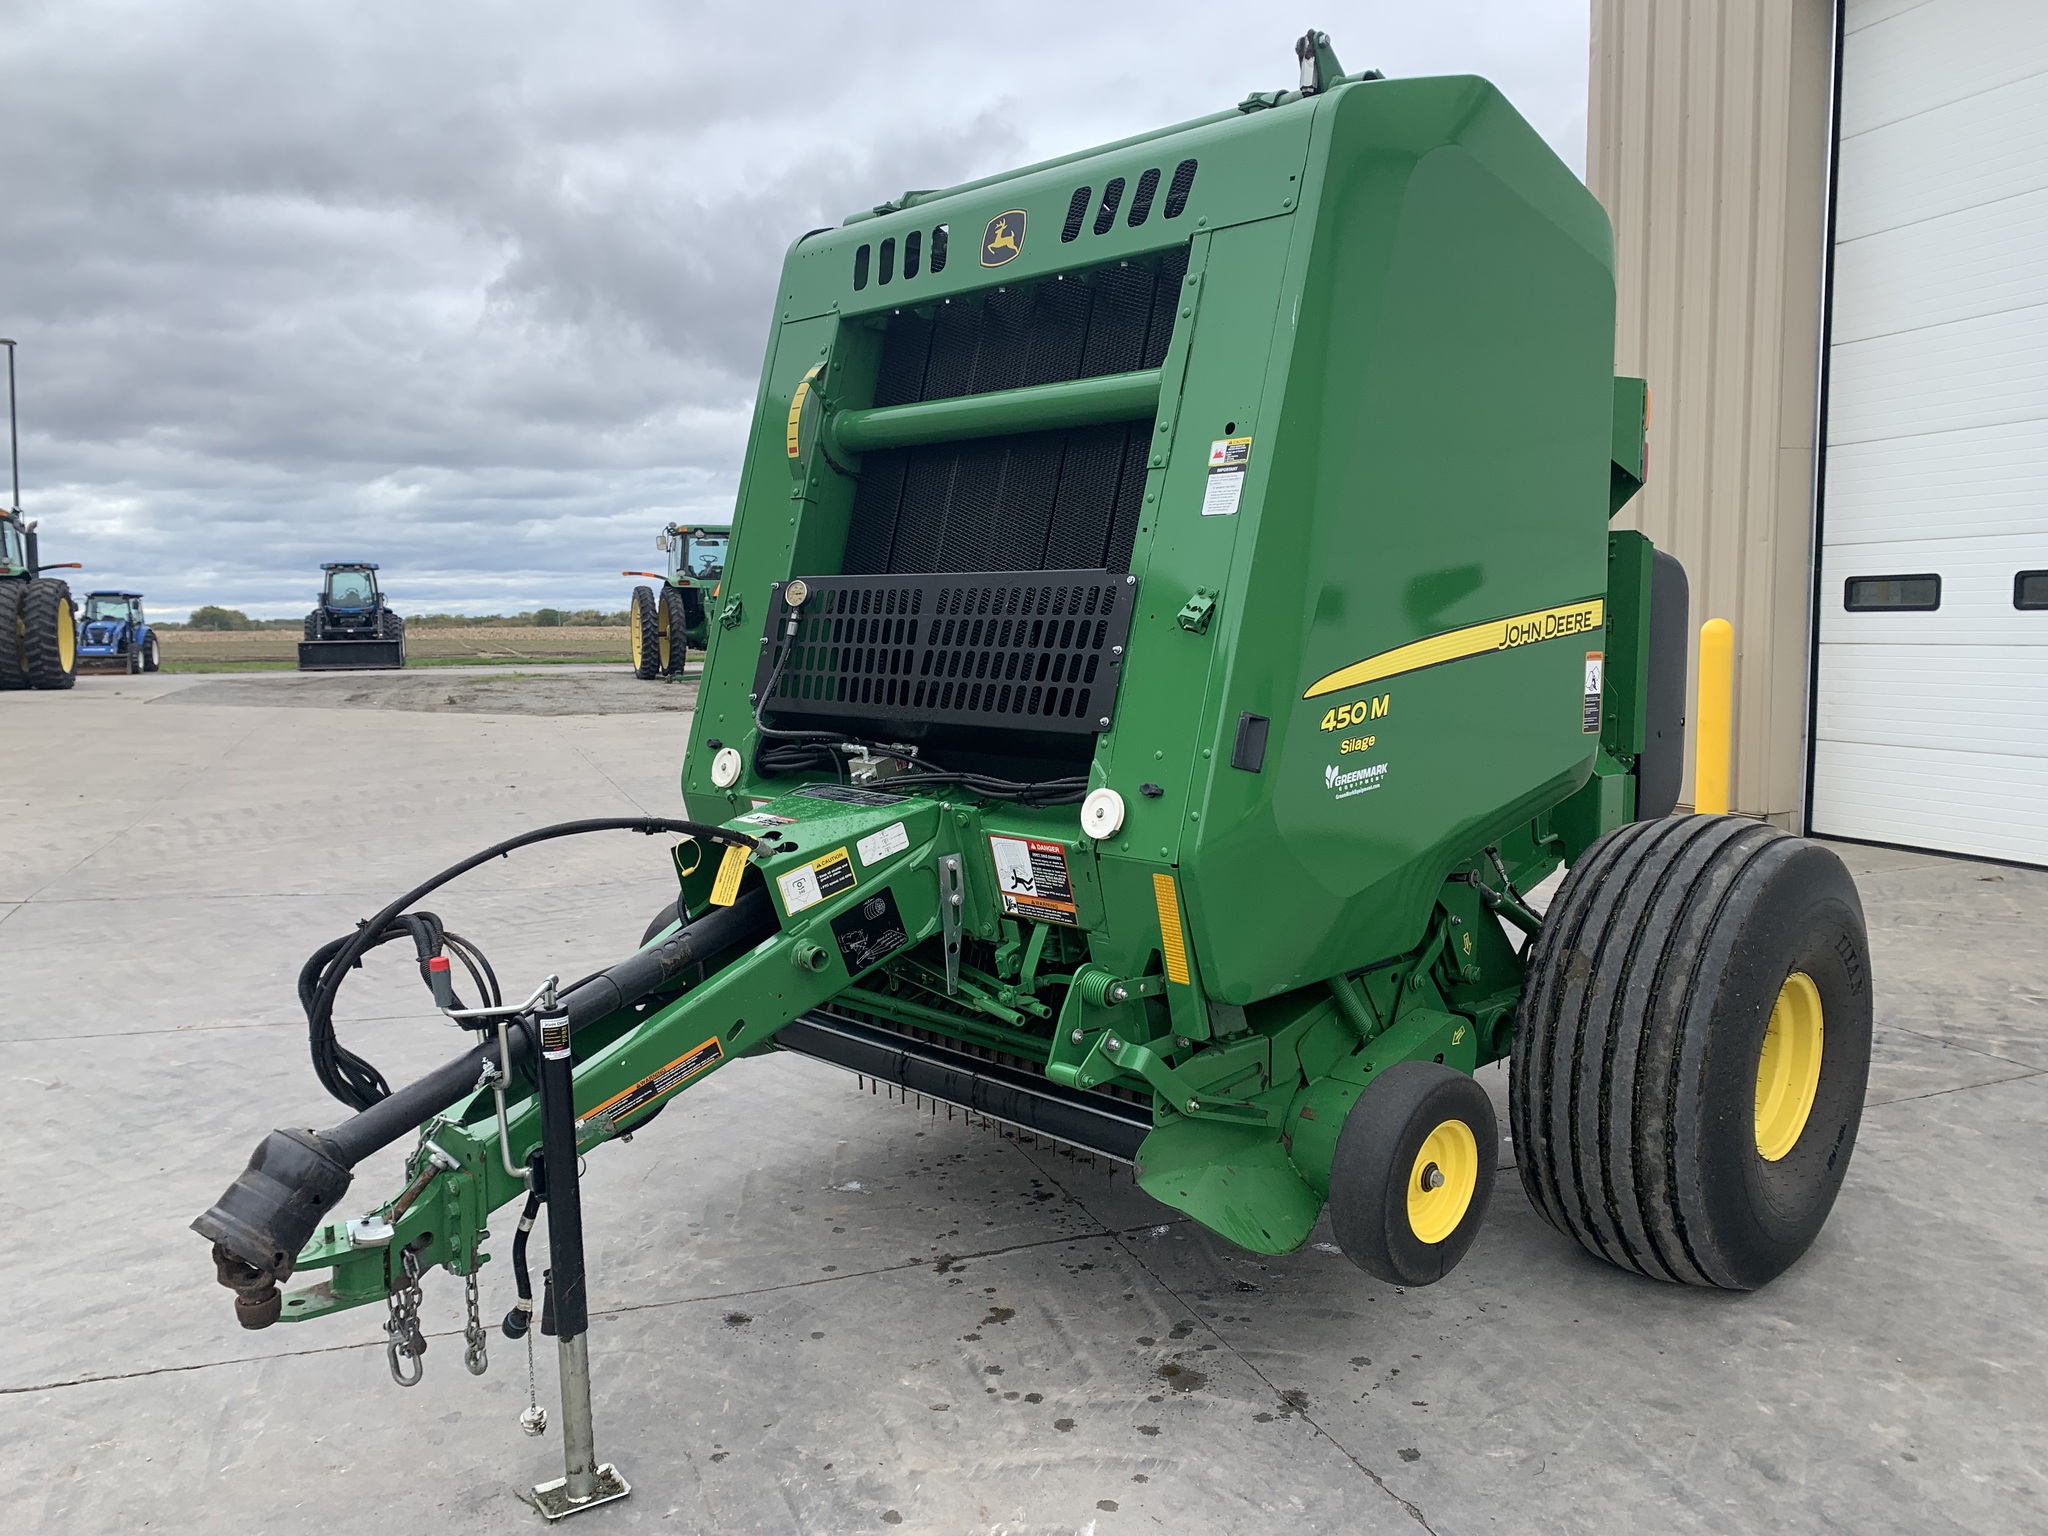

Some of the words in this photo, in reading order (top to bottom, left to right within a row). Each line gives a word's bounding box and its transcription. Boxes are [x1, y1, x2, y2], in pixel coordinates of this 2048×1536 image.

[1499, 620, 1542, 647] JOHN
[1545, 610, 1592, 636] DEERE
[1320, 700, 1367, 732] 450
[1371, 693, 1390, 720] M
[1340, 735, 1376, 755] Silage
[1335, 763, 1388, 787] GREENMARK
[1339, 775, 1384, 791] EQUIPMENT
[1036, 844, 1060, 853] DANGER
[822, 853, 843, 866] CAUTION
[1036, 900, 1058, 909] WARNING
[1835, 933, 1863, 996] TITAN
[641, 1068, 667, 1086] WARNING
